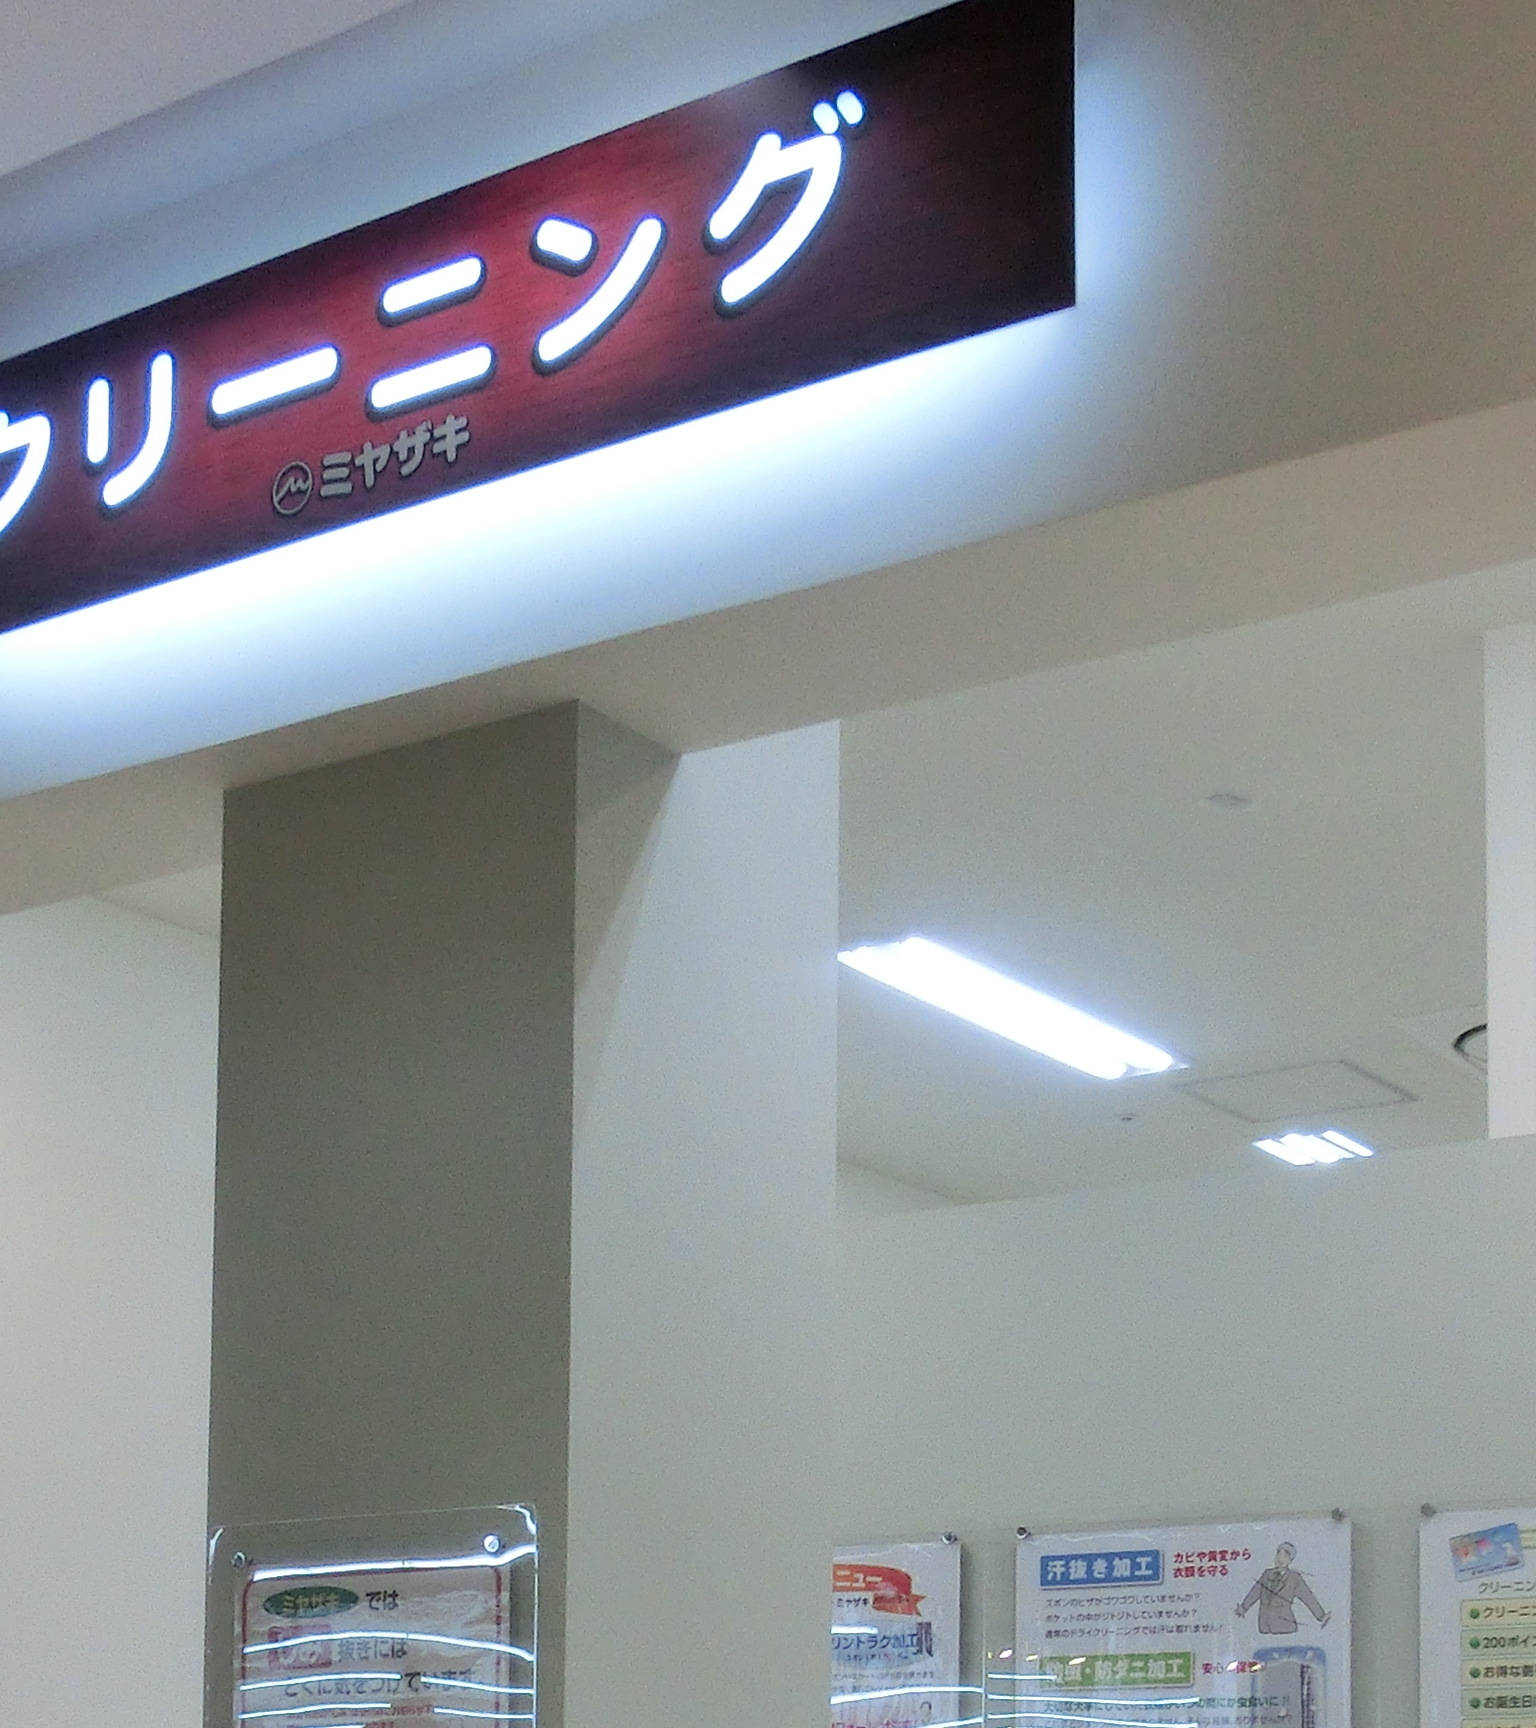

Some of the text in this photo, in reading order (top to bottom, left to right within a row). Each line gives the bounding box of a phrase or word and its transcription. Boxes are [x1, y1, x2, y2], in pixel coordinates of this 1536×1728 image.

[318, 413, 472, 502] ミヤザキ
[1047, 1556, 1153, 1581] 汗抜き加工
